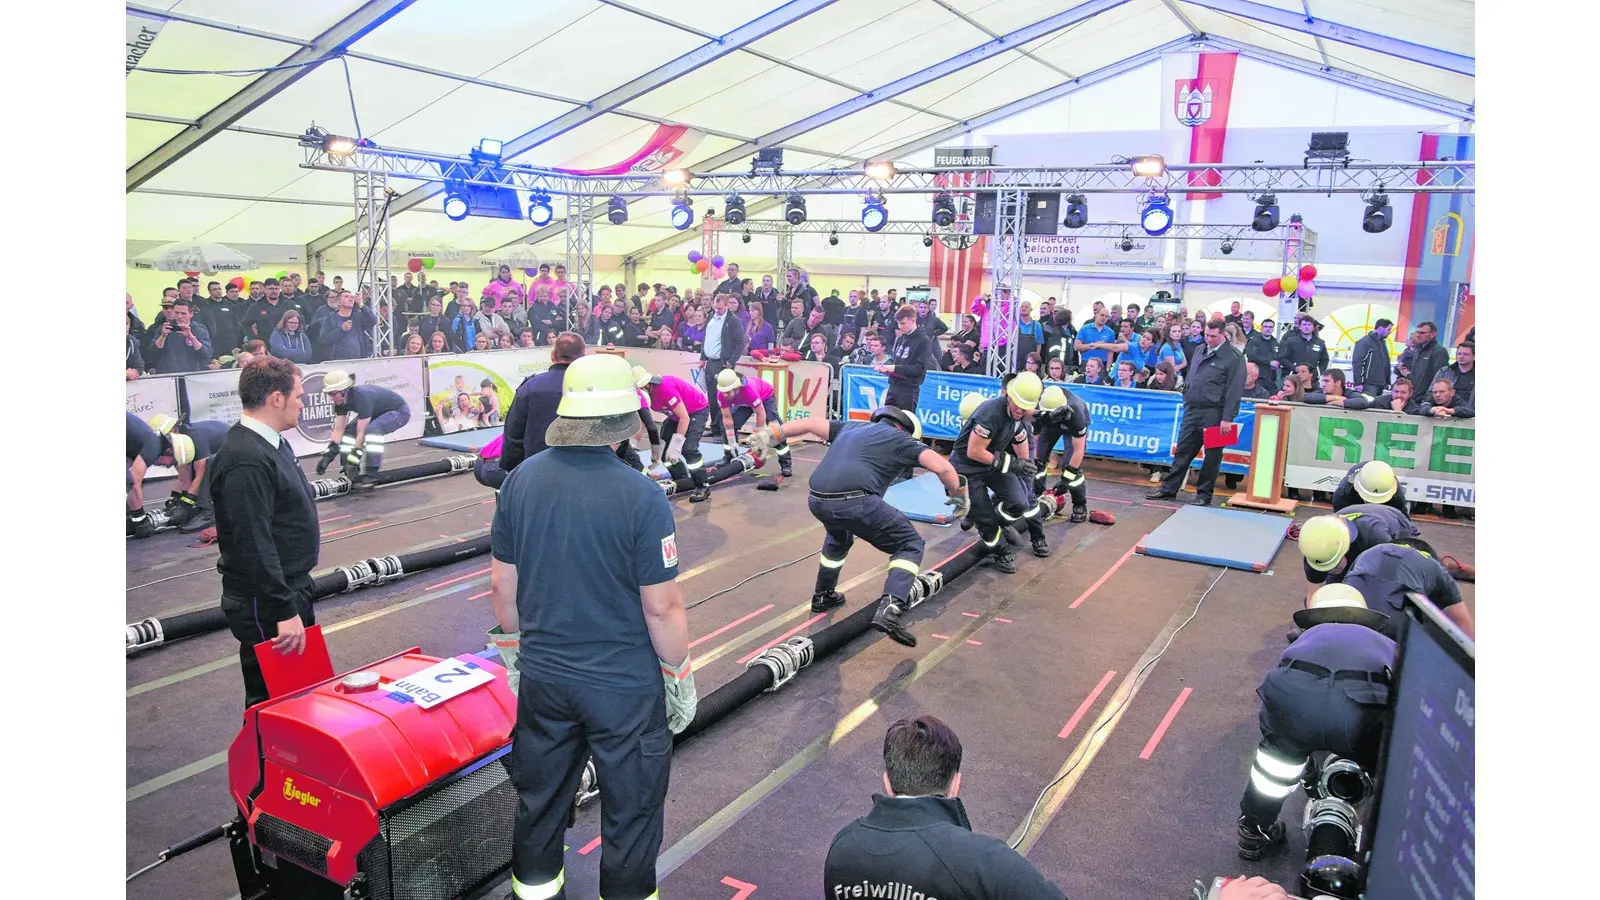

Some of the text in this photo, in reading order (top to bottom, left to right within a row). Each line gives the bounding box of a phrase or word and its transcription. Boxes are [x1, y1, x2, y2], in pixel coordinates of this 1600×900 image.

[126, 26, 157, 77] acher
[936, 155, 990, 165] FEUERWEHR
[1006, 243, 1080, 254] Kpelcontest
[1028, 256, 1049, 264] April
[208, 391, 229, 399] DENNIS
[302, 404, 337, 420] HAMEL
[920, 408, 966, 427] Volks
[434, 667, 472, 684] 2
[395, 681, 442, 703] Bahn
